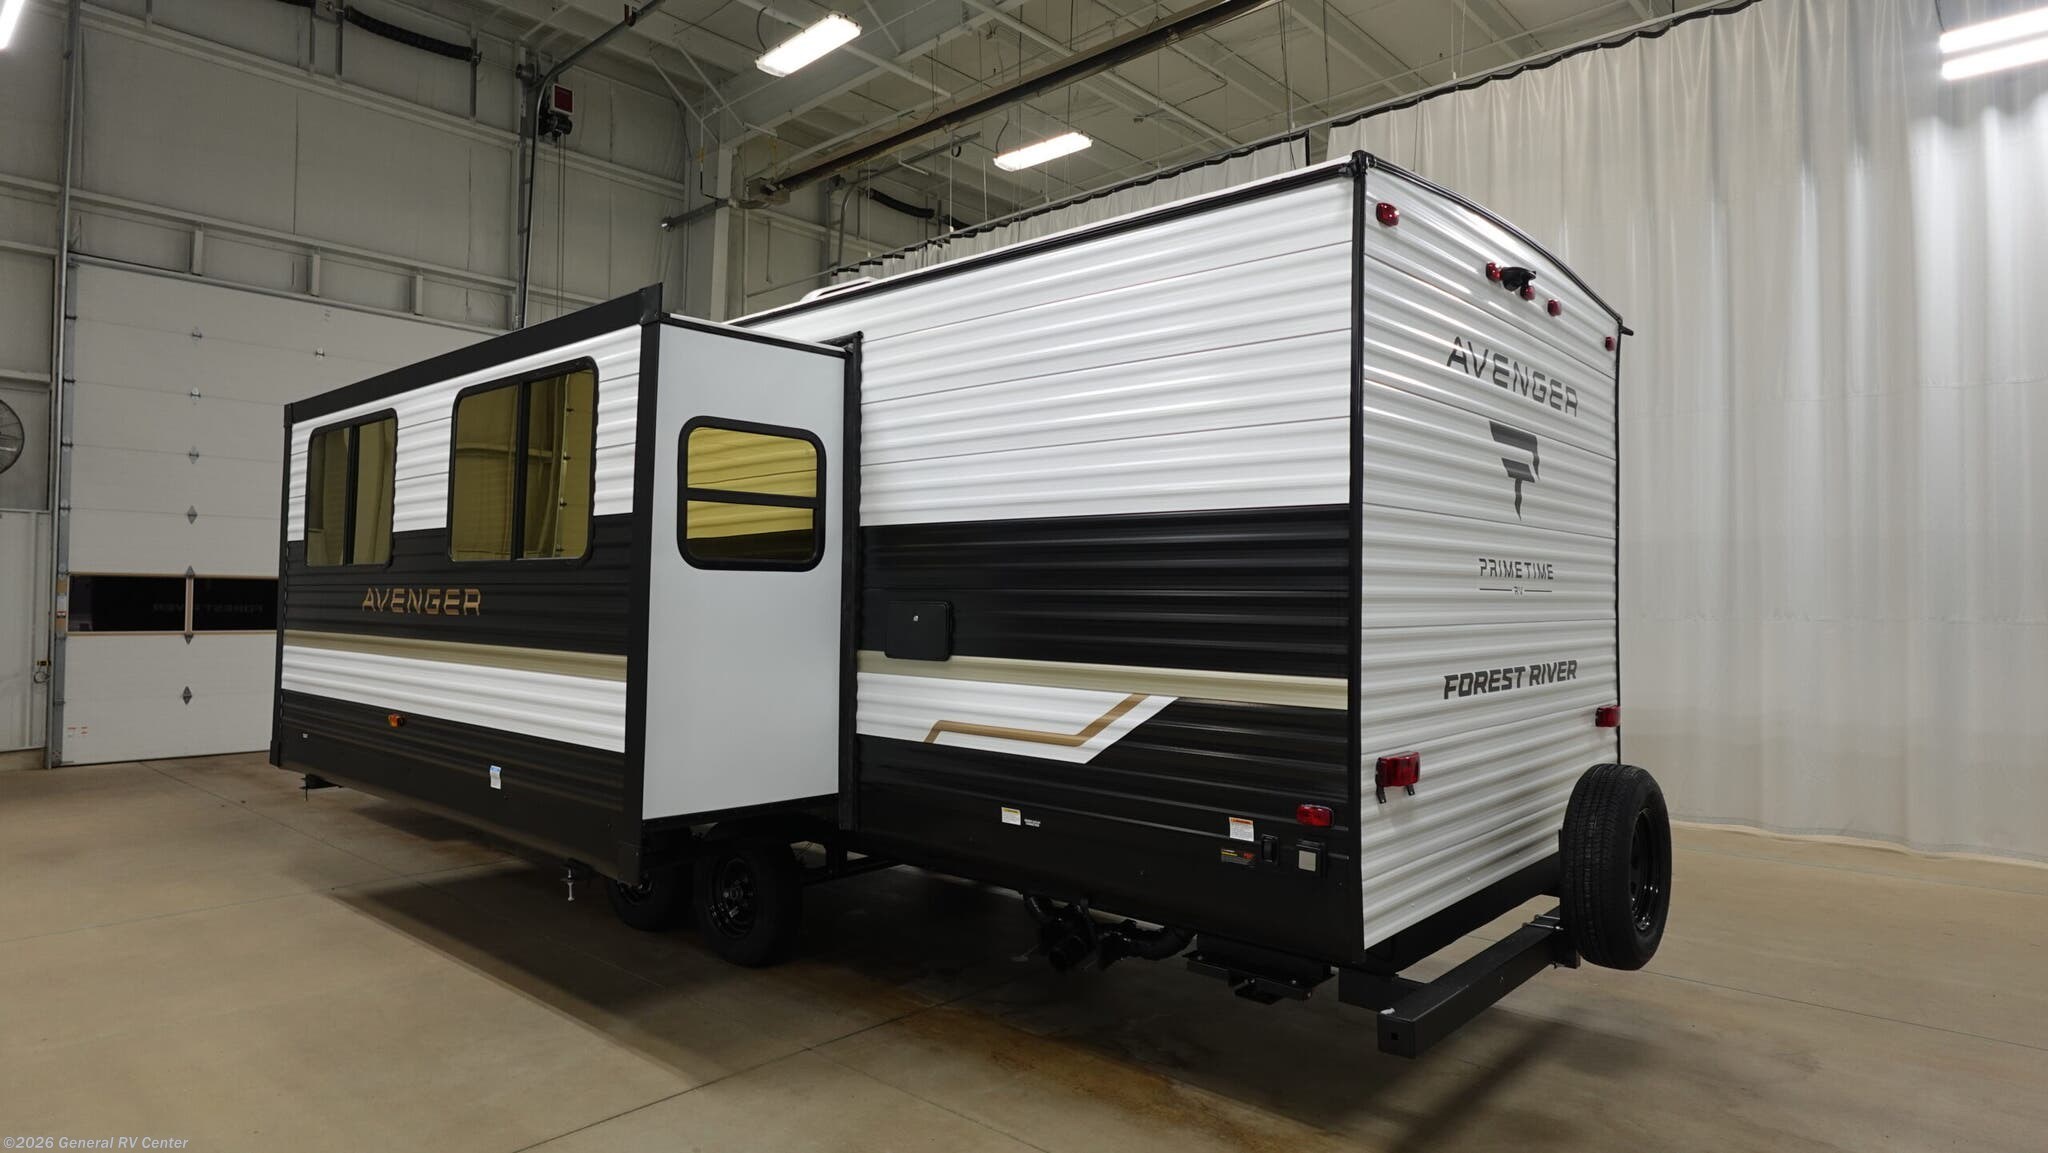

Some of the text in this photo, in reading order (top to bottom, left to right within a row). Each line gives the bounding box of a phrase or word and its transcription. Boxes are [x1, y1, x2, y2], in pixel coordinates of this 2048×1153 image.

[1447, 336, 1578, 417] AVENGER
[362, 587, 481, 616] AVENGER
[1444, 660, 1578, 700] FOREST RIVER
